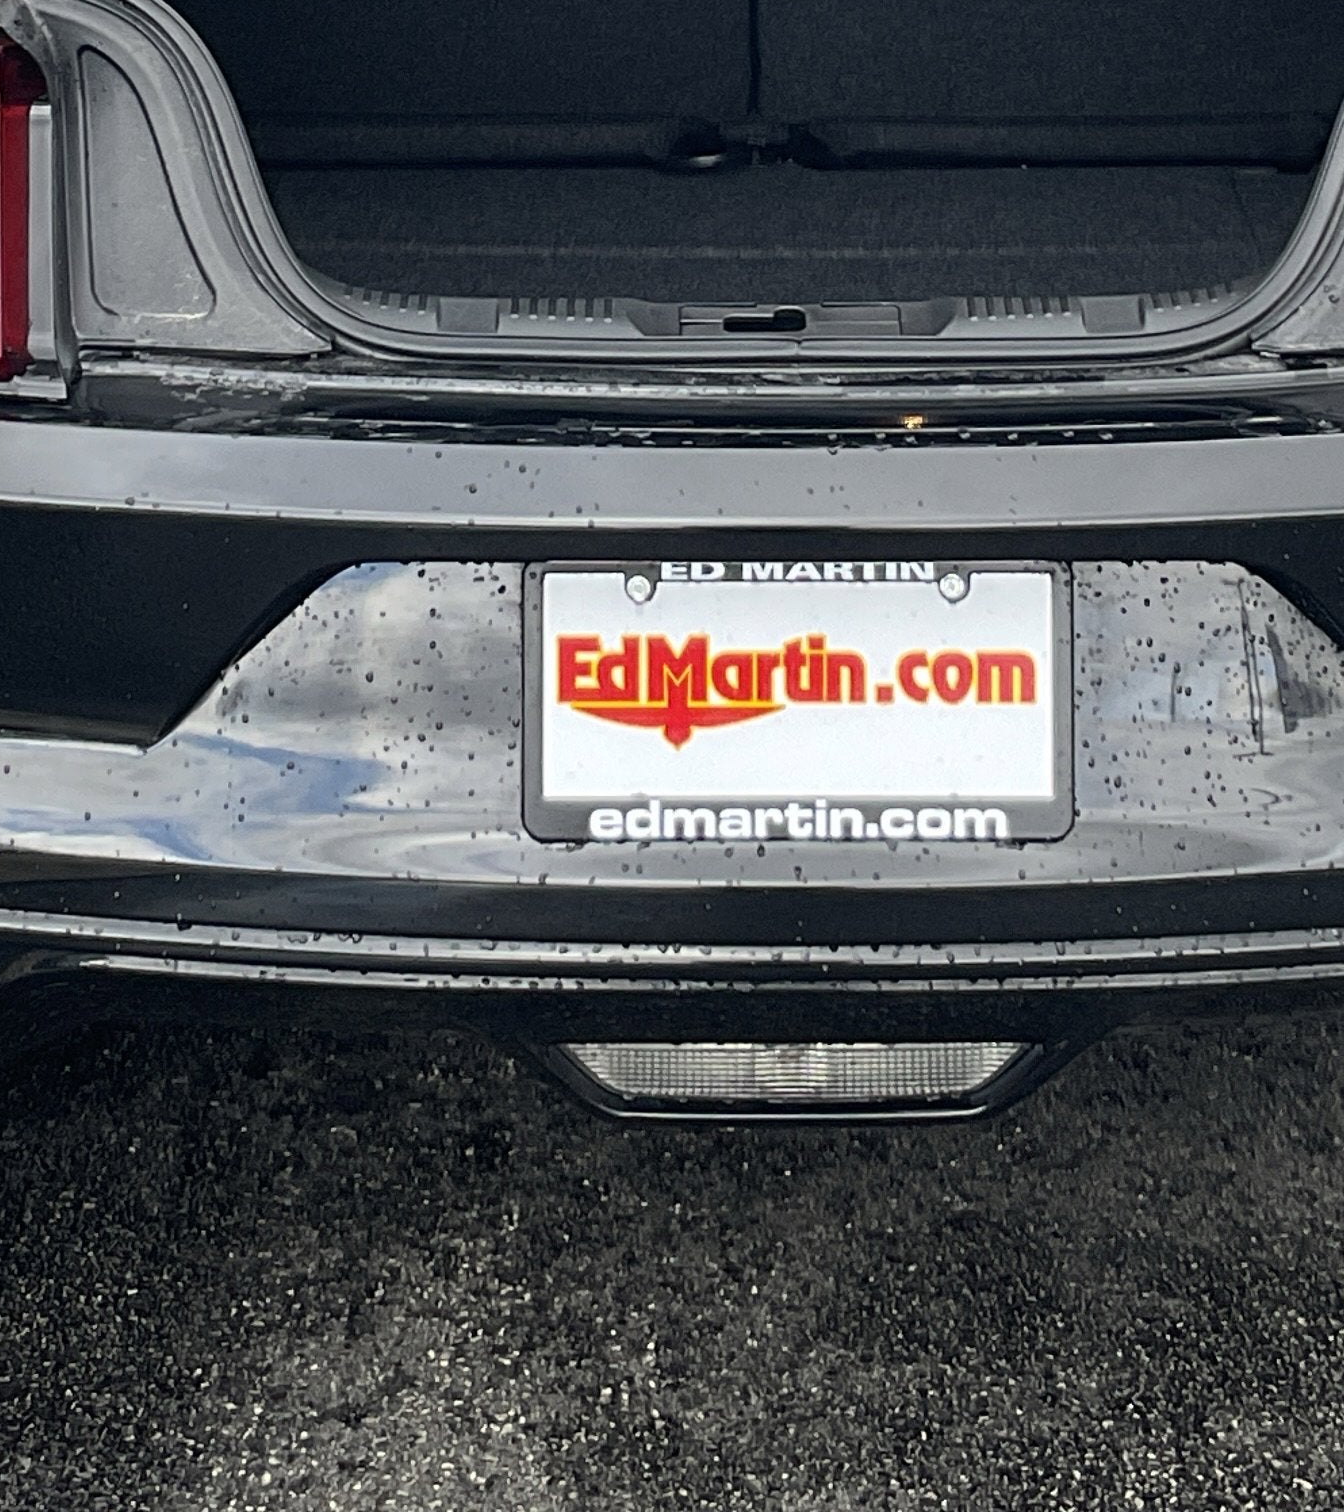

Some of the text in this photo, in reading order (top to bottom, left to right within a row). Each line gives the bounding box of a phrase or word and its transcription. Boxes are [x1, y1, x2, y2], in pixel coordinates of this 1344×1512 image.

[660, 561, 935, 581] ED MARTIN
[556, 633, 1038, 750] EdMartin.com
[588, 798, 1010, 840] edmartin.com
